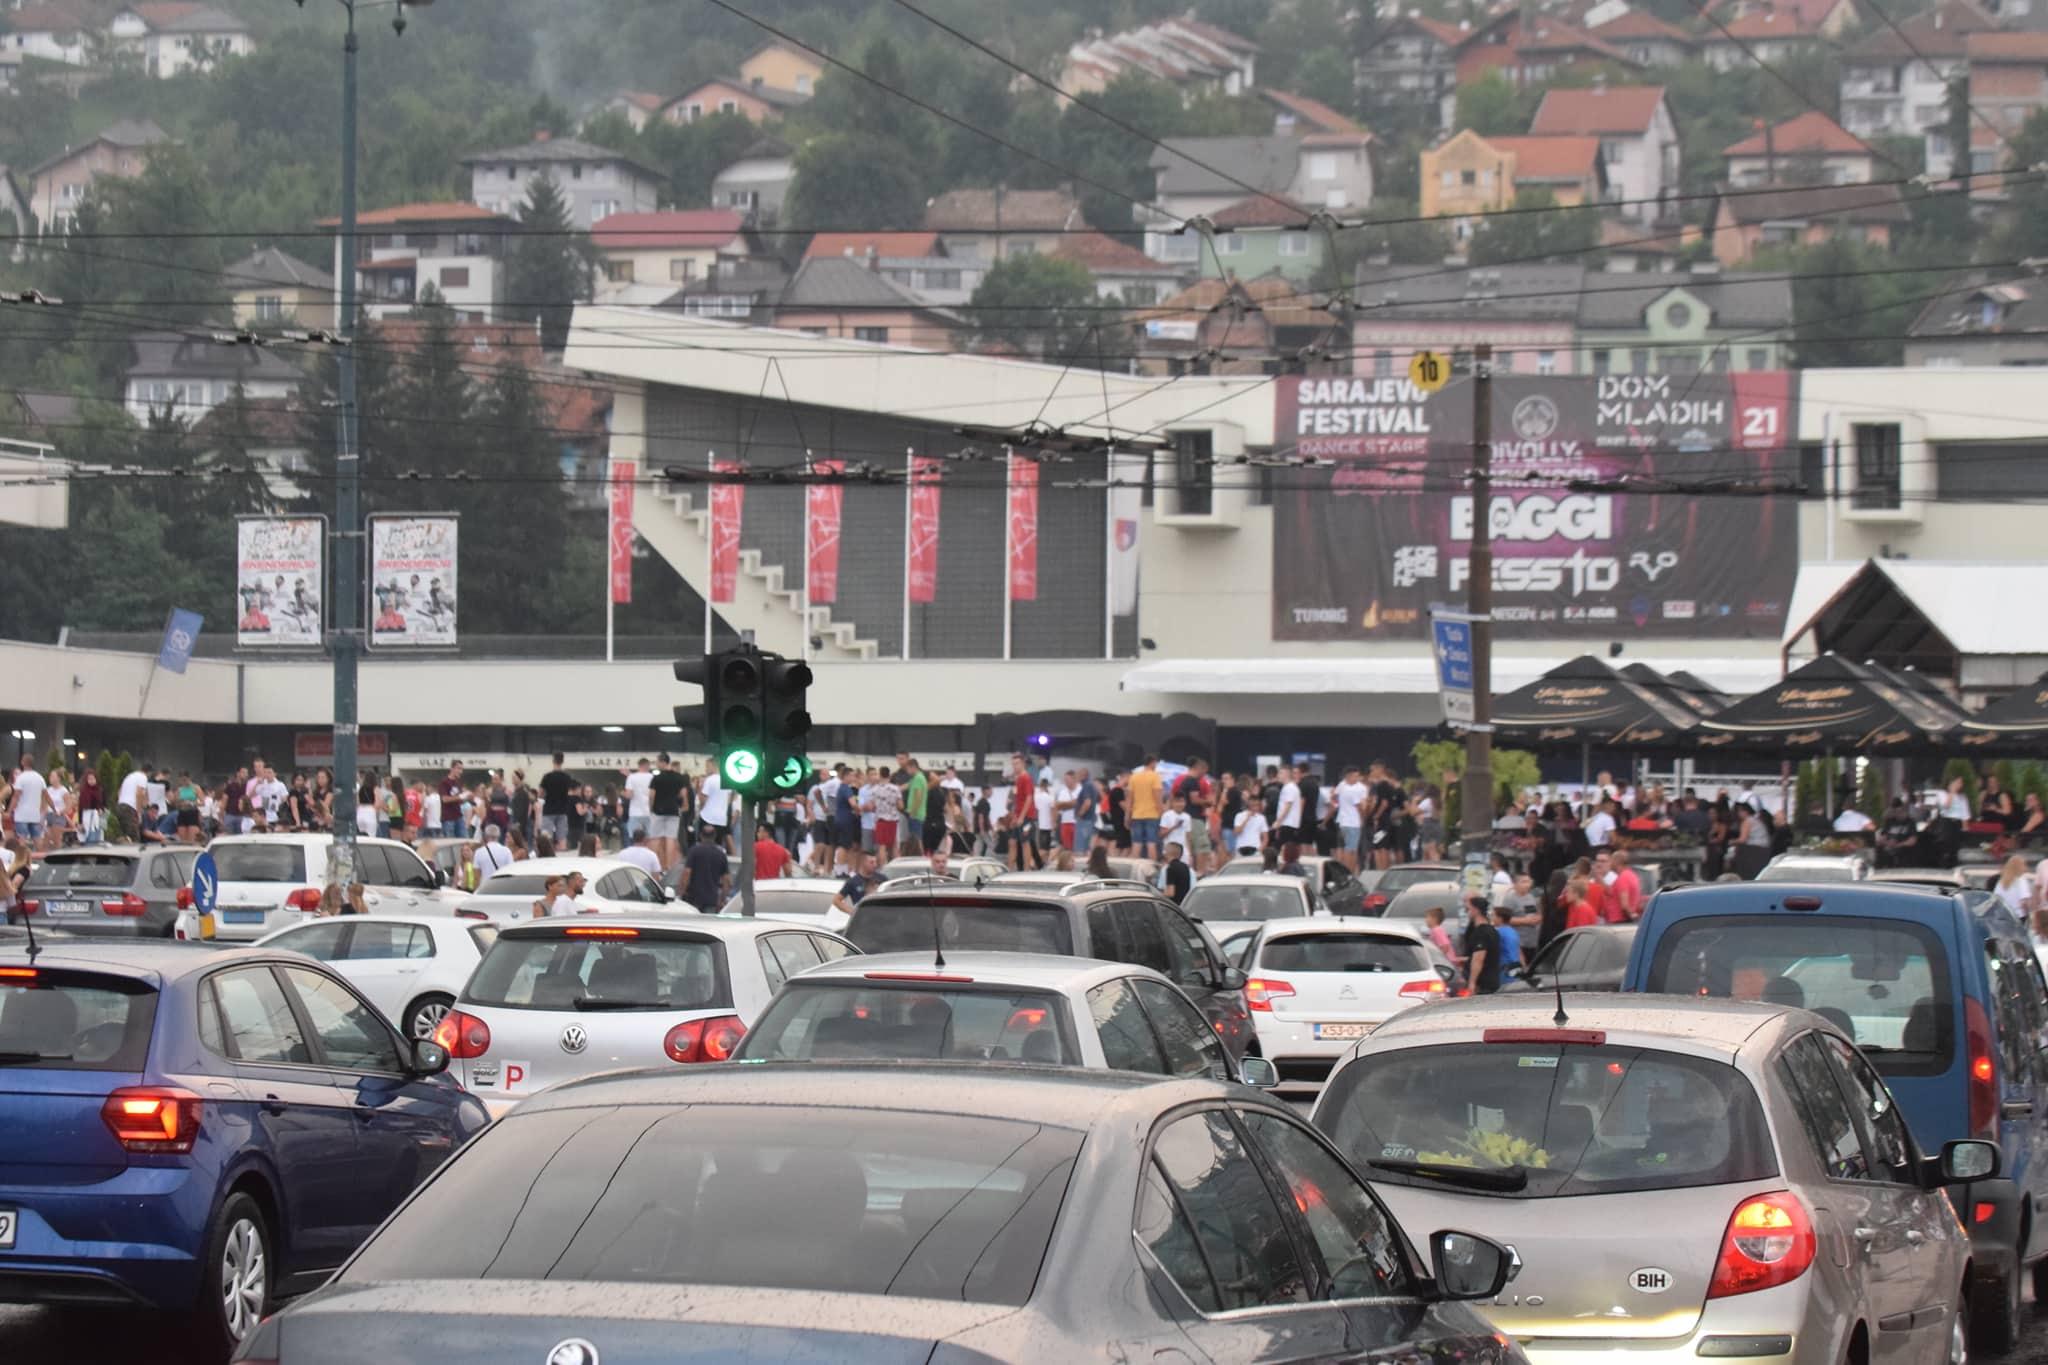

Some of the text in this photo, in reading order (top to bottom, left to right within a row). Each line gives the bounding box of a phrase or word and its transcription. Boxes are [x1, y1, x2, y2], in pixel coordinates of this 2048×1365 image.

[1418, 360, 1439, 382] 10
[1597, 375, 1670, 399] DOM
[1297, 406, 1431, 435] FESTIVAL
[1596, 400, 1724, 426] MLADIH
[1742, 406, 1778, 436] 21
[1300, 437, 1426, 455] DANCE STAGE
[504, 1065, 524, 1090] P
[1636, 1273, 1666, 1288] BIH
[1473, 1295, 1545, 1307] LIO
